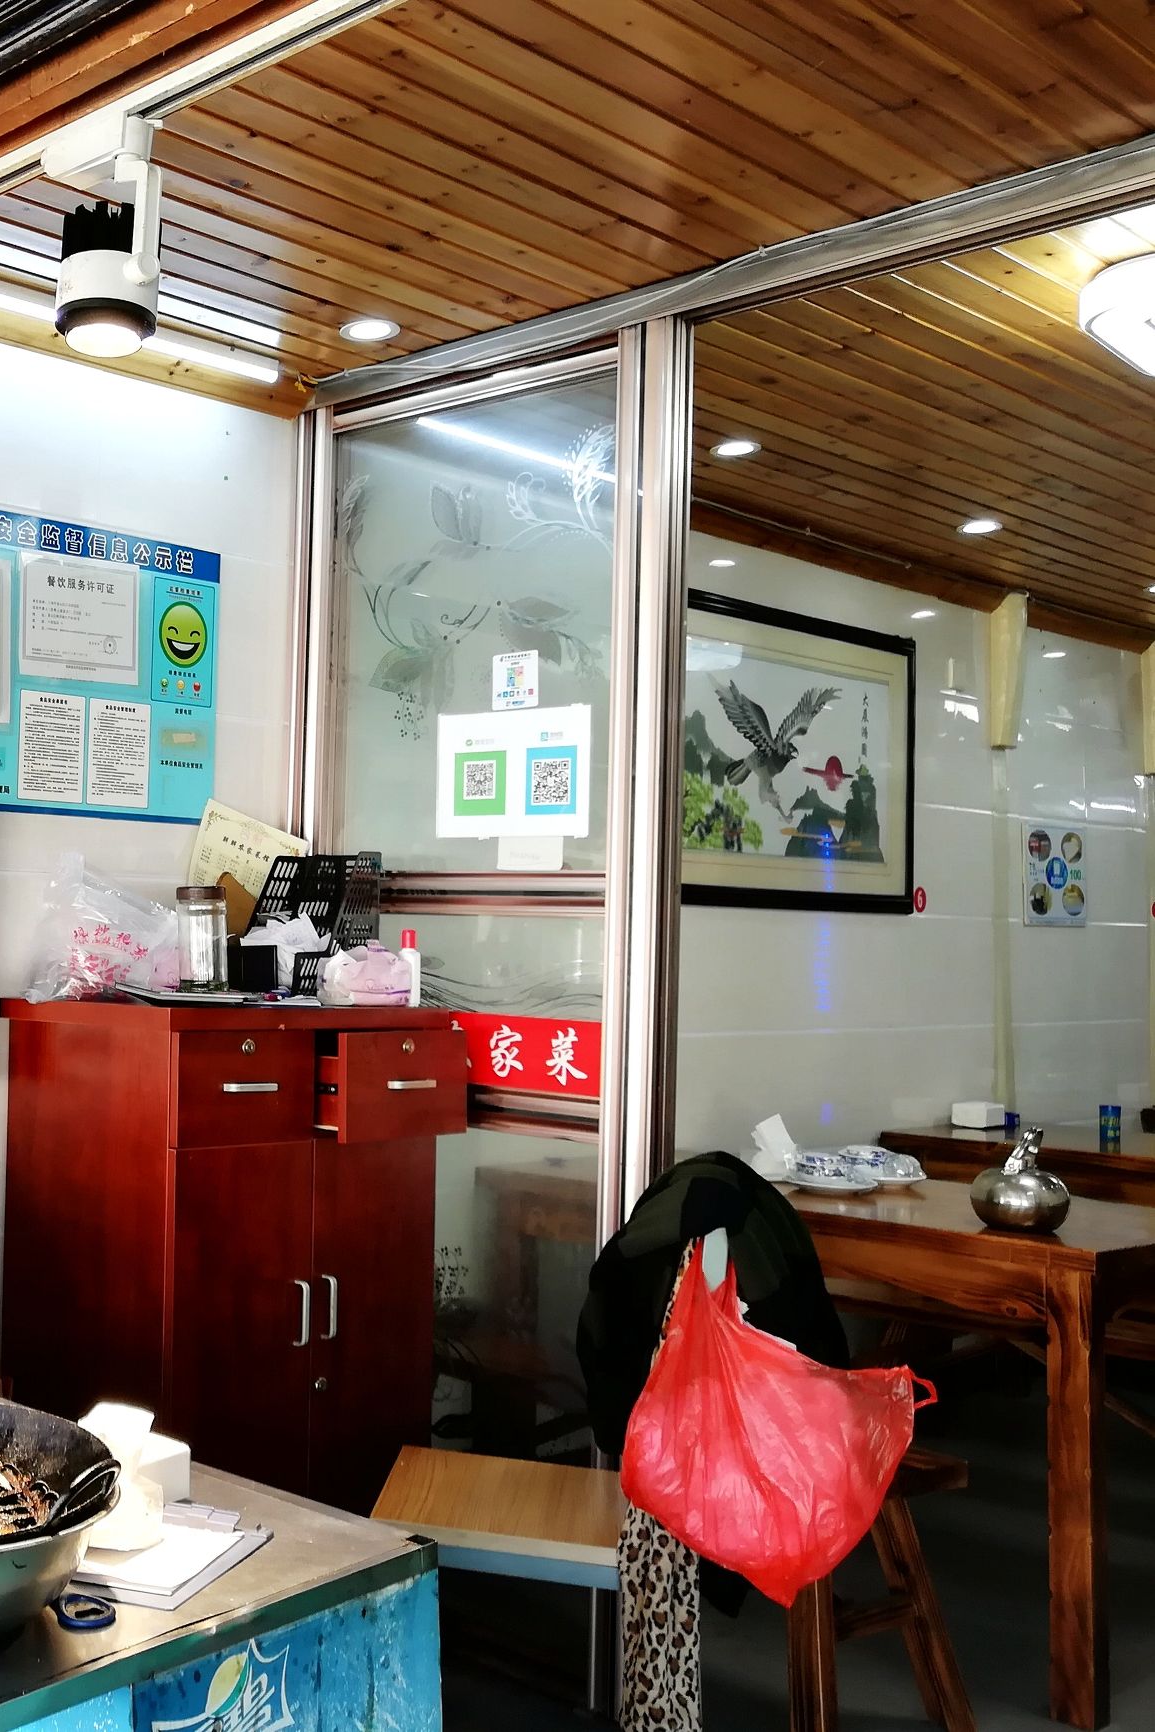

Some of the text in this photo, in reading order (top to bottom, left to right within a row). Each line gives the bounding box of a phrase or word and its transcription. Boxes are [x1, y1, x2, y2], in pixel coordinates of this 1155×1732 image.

[46, 574, 115, 595] 餐饮服务许可证
[451, 1019, 588, 1086] 家菜
